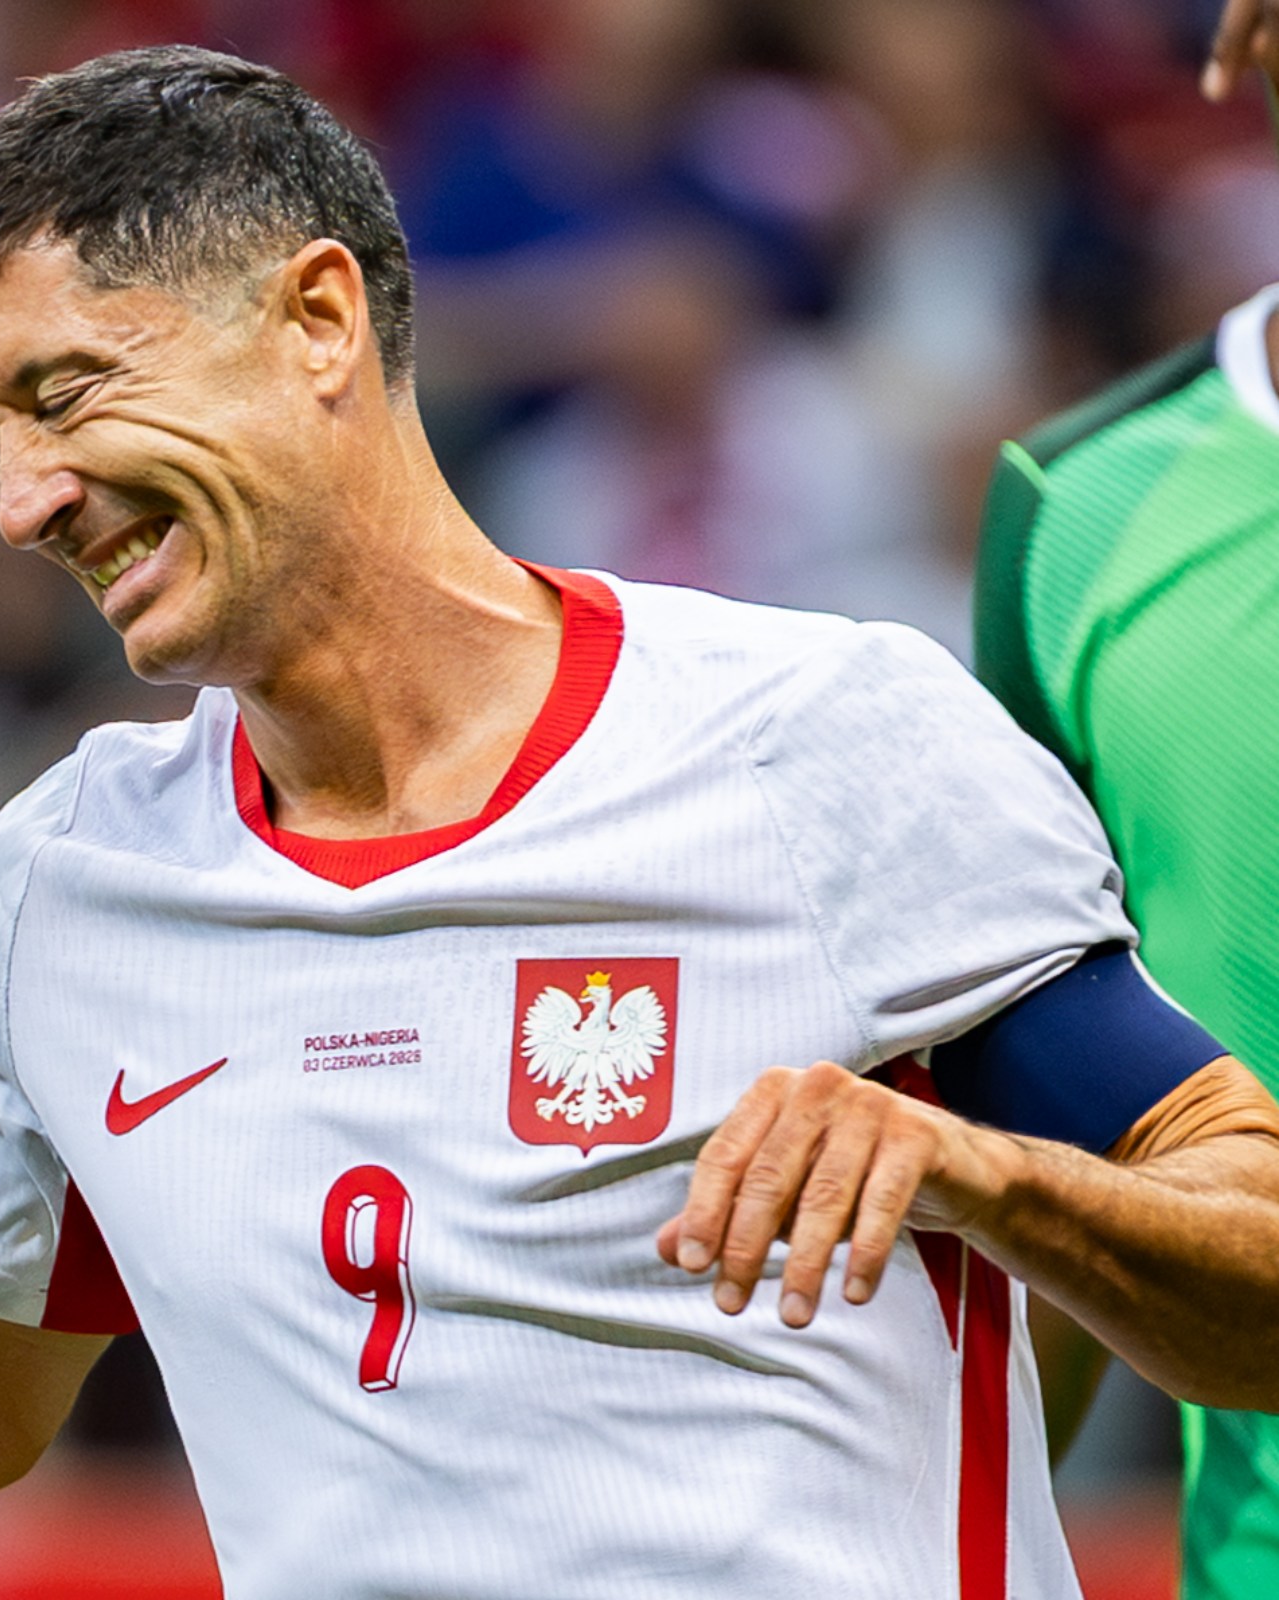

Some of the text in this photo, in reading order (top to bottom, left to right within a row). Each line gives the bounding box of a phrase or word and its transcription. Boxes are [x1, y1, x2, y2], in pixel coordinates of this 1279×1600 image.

[304, 1028, 419, 1052] POLSKA-NIGERIA
[303, 1058, 319, 1073] 03
[322, 1053, 386, 1071] CZERWCA
[321, 1164, 416, 1393] 9
